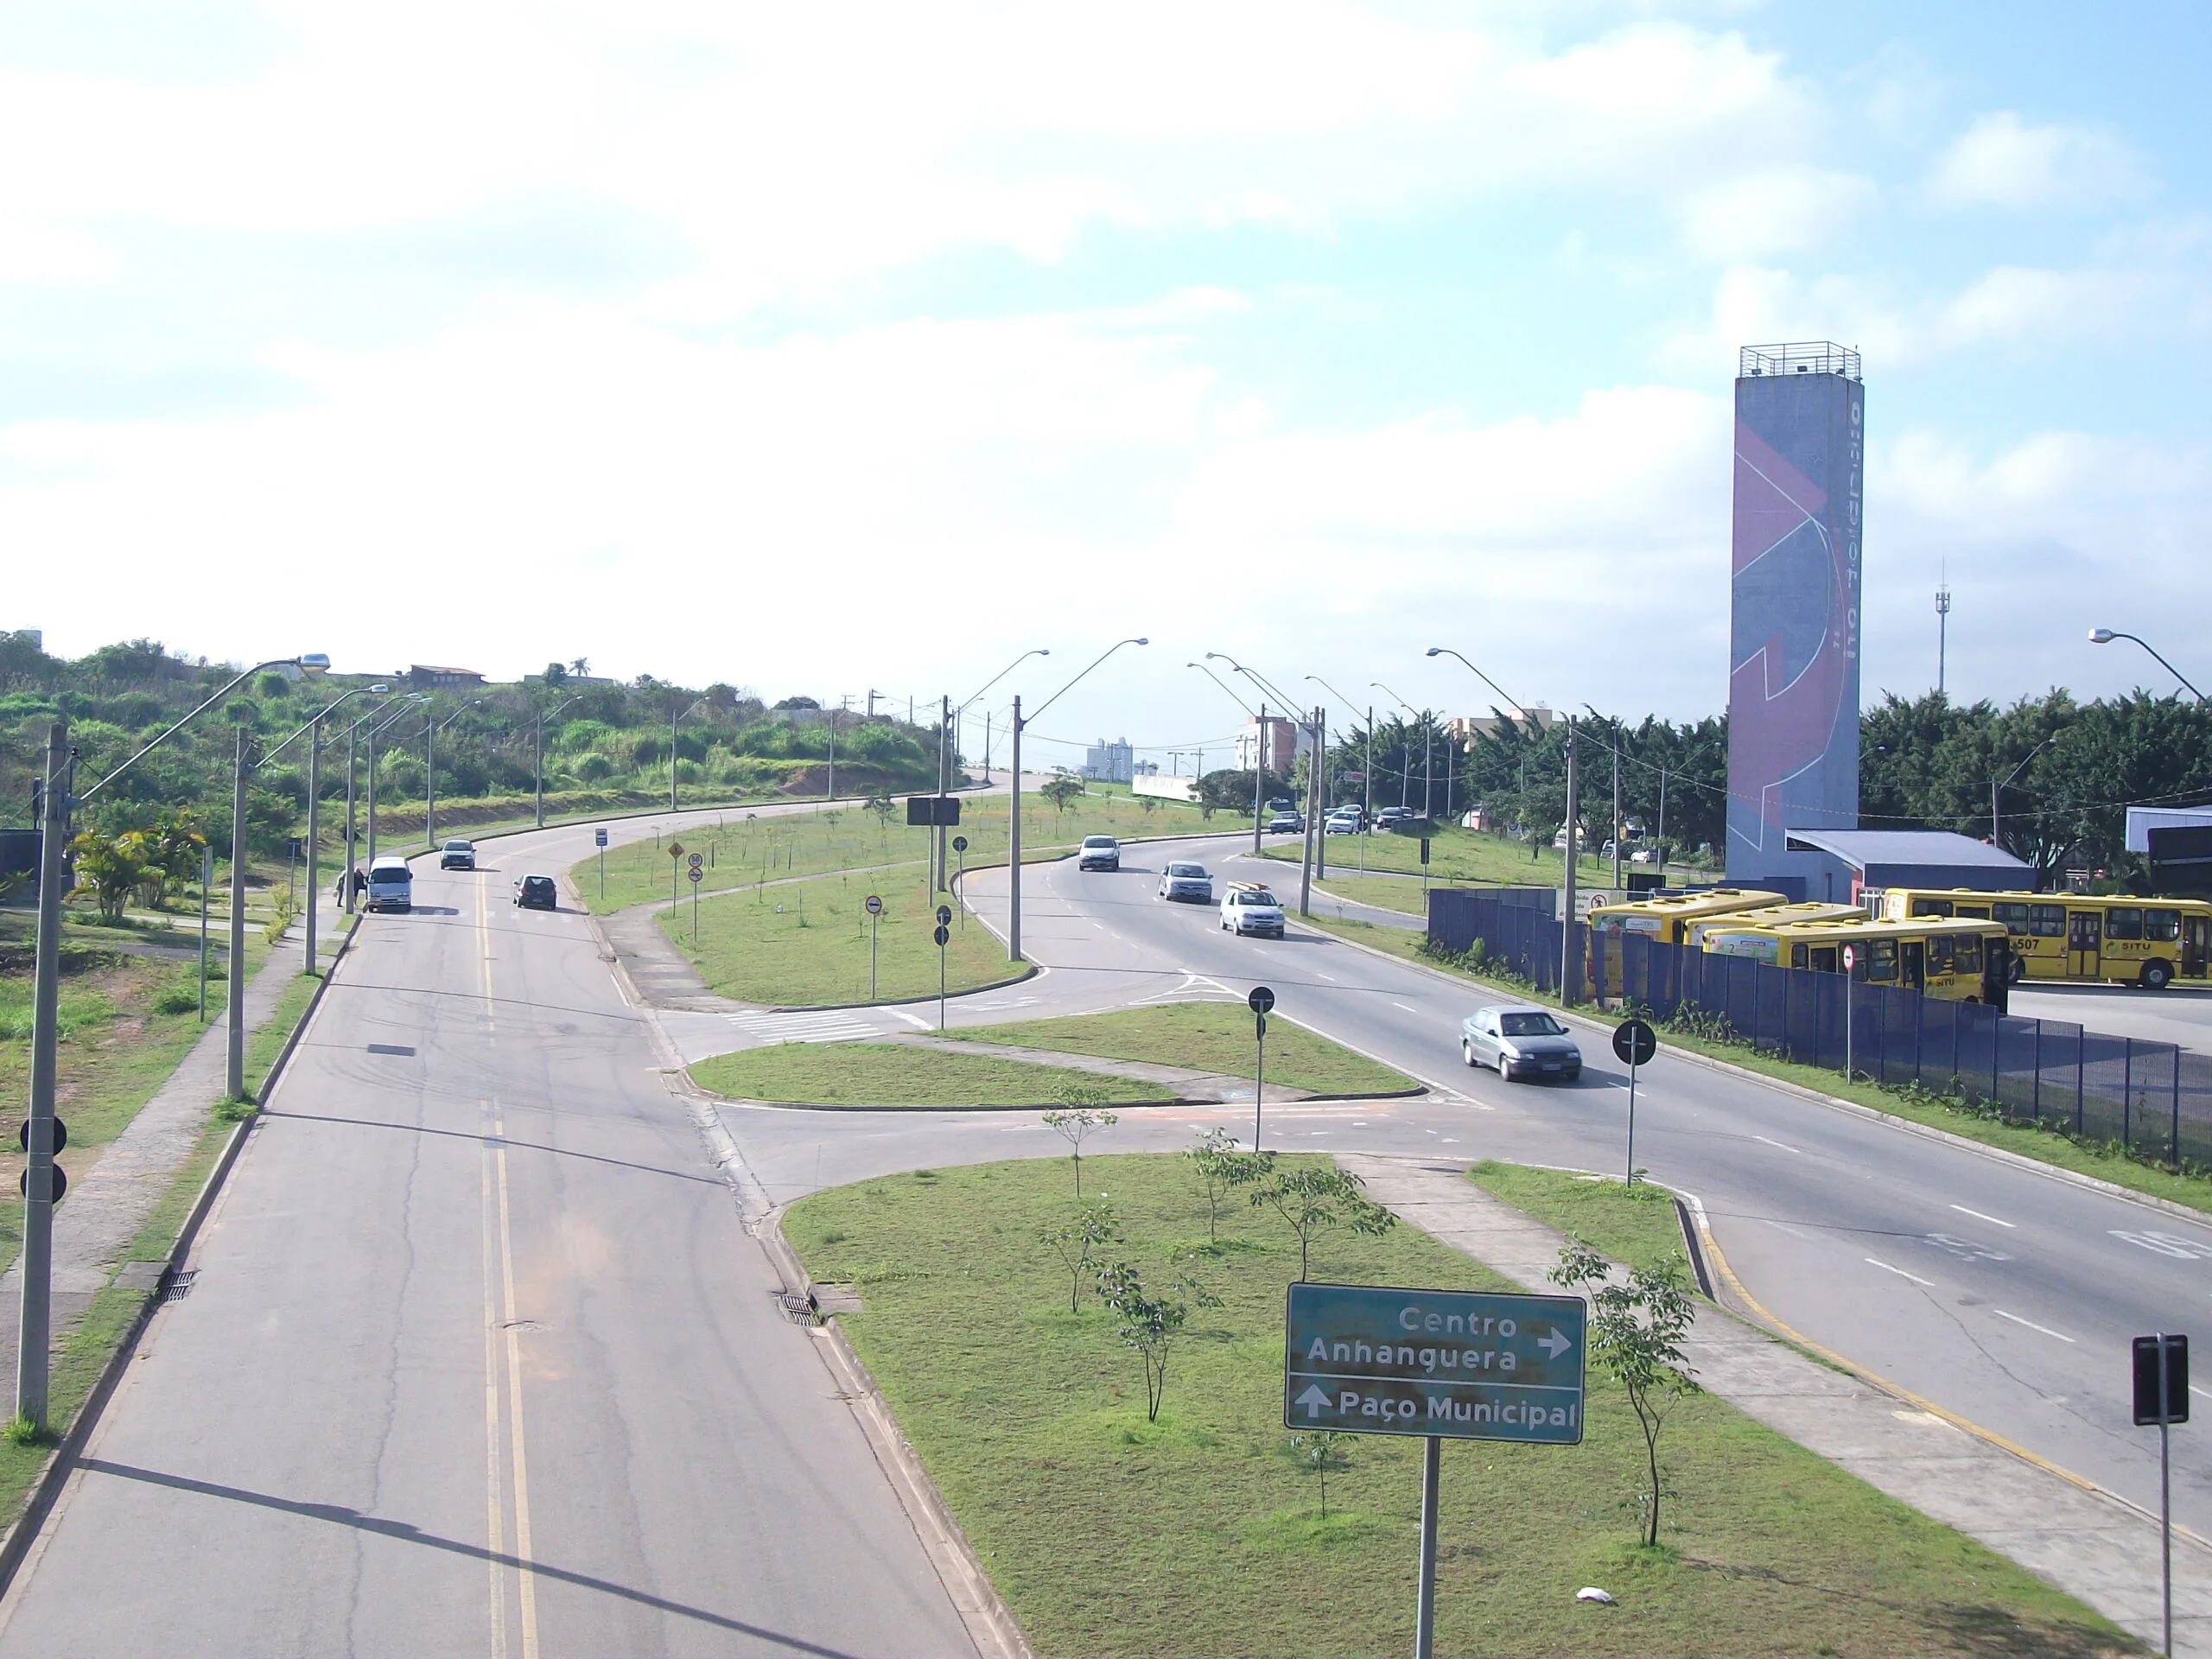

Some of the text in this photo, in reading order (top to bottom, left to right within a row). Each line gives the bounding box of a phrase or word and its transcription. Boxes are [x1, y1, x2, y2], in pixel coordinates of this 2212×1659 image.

[2012, 938, 2039, 950] 507
[1399, 1306, 1517, 1338] Centro
[1307, 1337, 1517, 1373] Anhanguera
[1339, 1391, 1575, 1431] Paço Municipal
